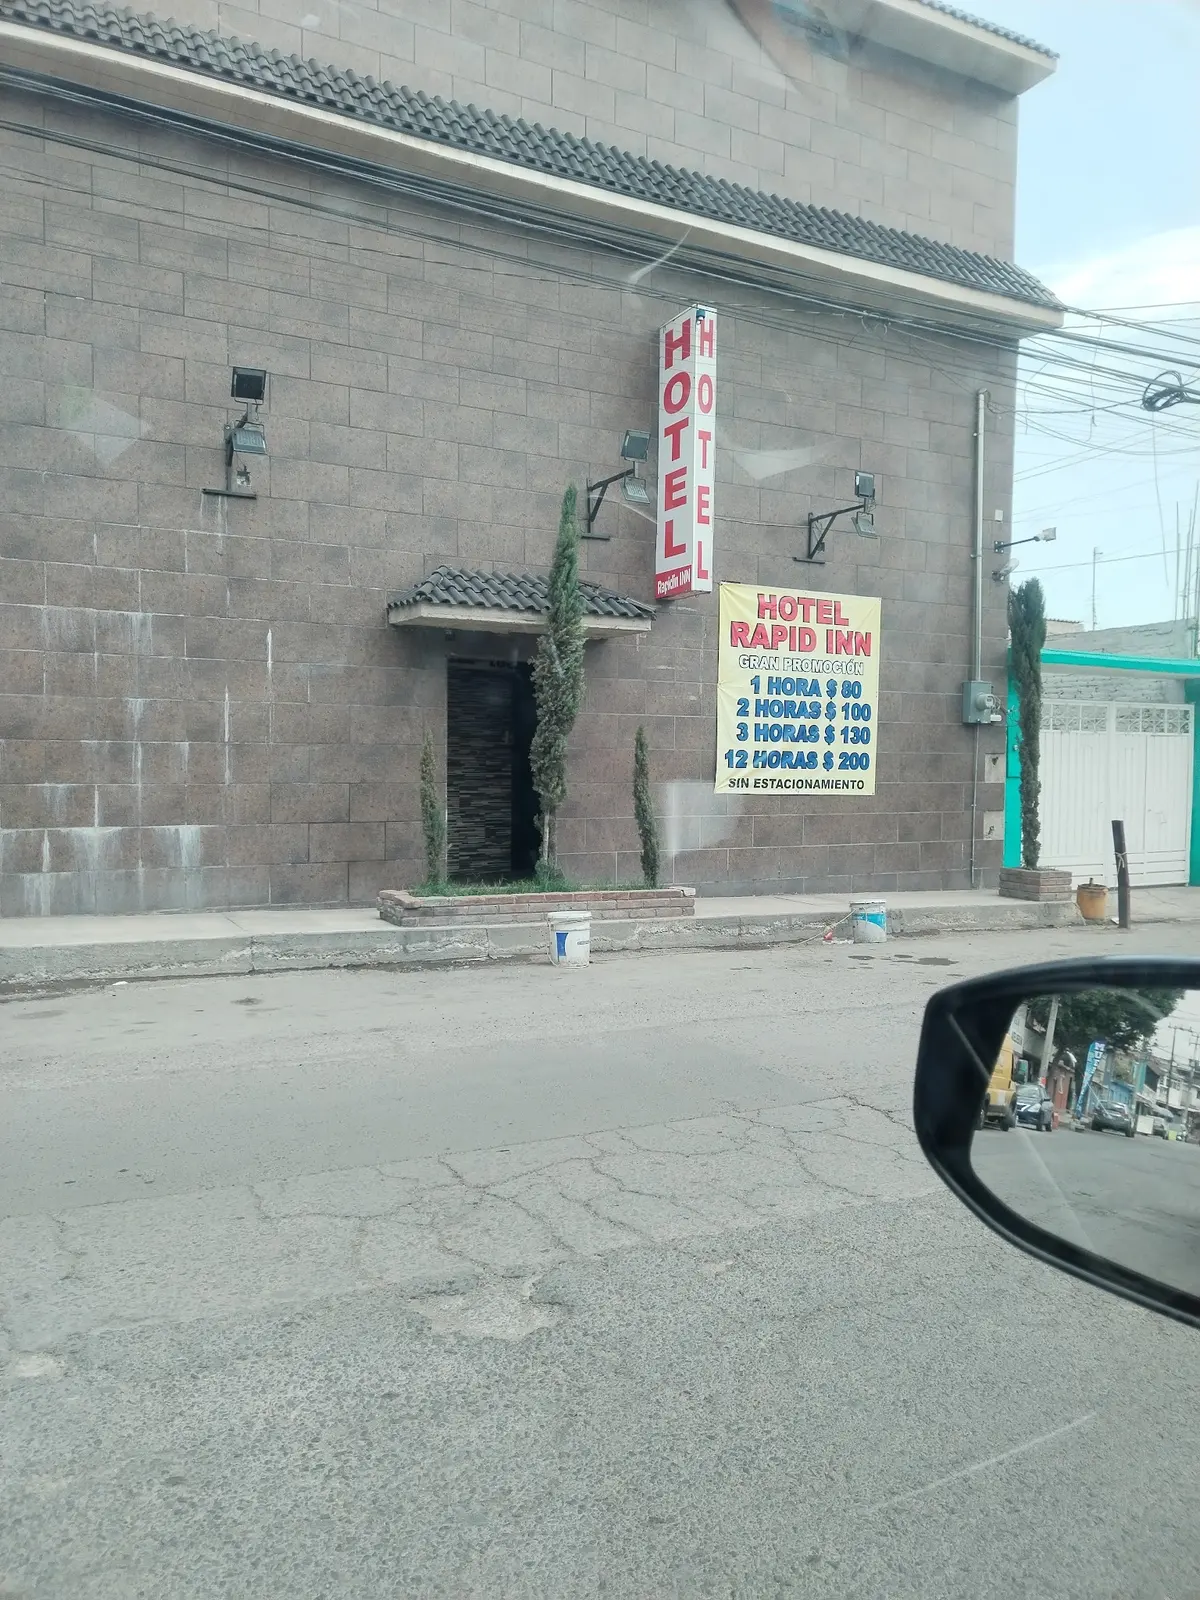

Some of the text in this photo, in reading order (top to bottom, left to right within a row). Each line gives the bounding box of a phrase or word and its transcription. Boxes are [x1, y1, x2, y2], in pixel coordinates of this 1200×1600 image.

[664, 318, 692, 558] HOTEL
[697, 319, 714, 580] HOTEL
[679, 568, 691, 586] INN
[757, 593, 849, 626] HOTEL
[730, 621, 872, 656] RAPID INN
[739, 654, 864, 675] GRAN PROMOCIÓN
[750, 675, 862, 699] 1 HORA $ 80
[736, 698, 871, 721] 2 HORAS $ 100
[736, 722, 871, 745] 3 HORAS $ 130
[725, 749, 870, 771] 12 HORAS $ 200
[728, 777, 865, 790] SIN ESTACIONAMIENTO
